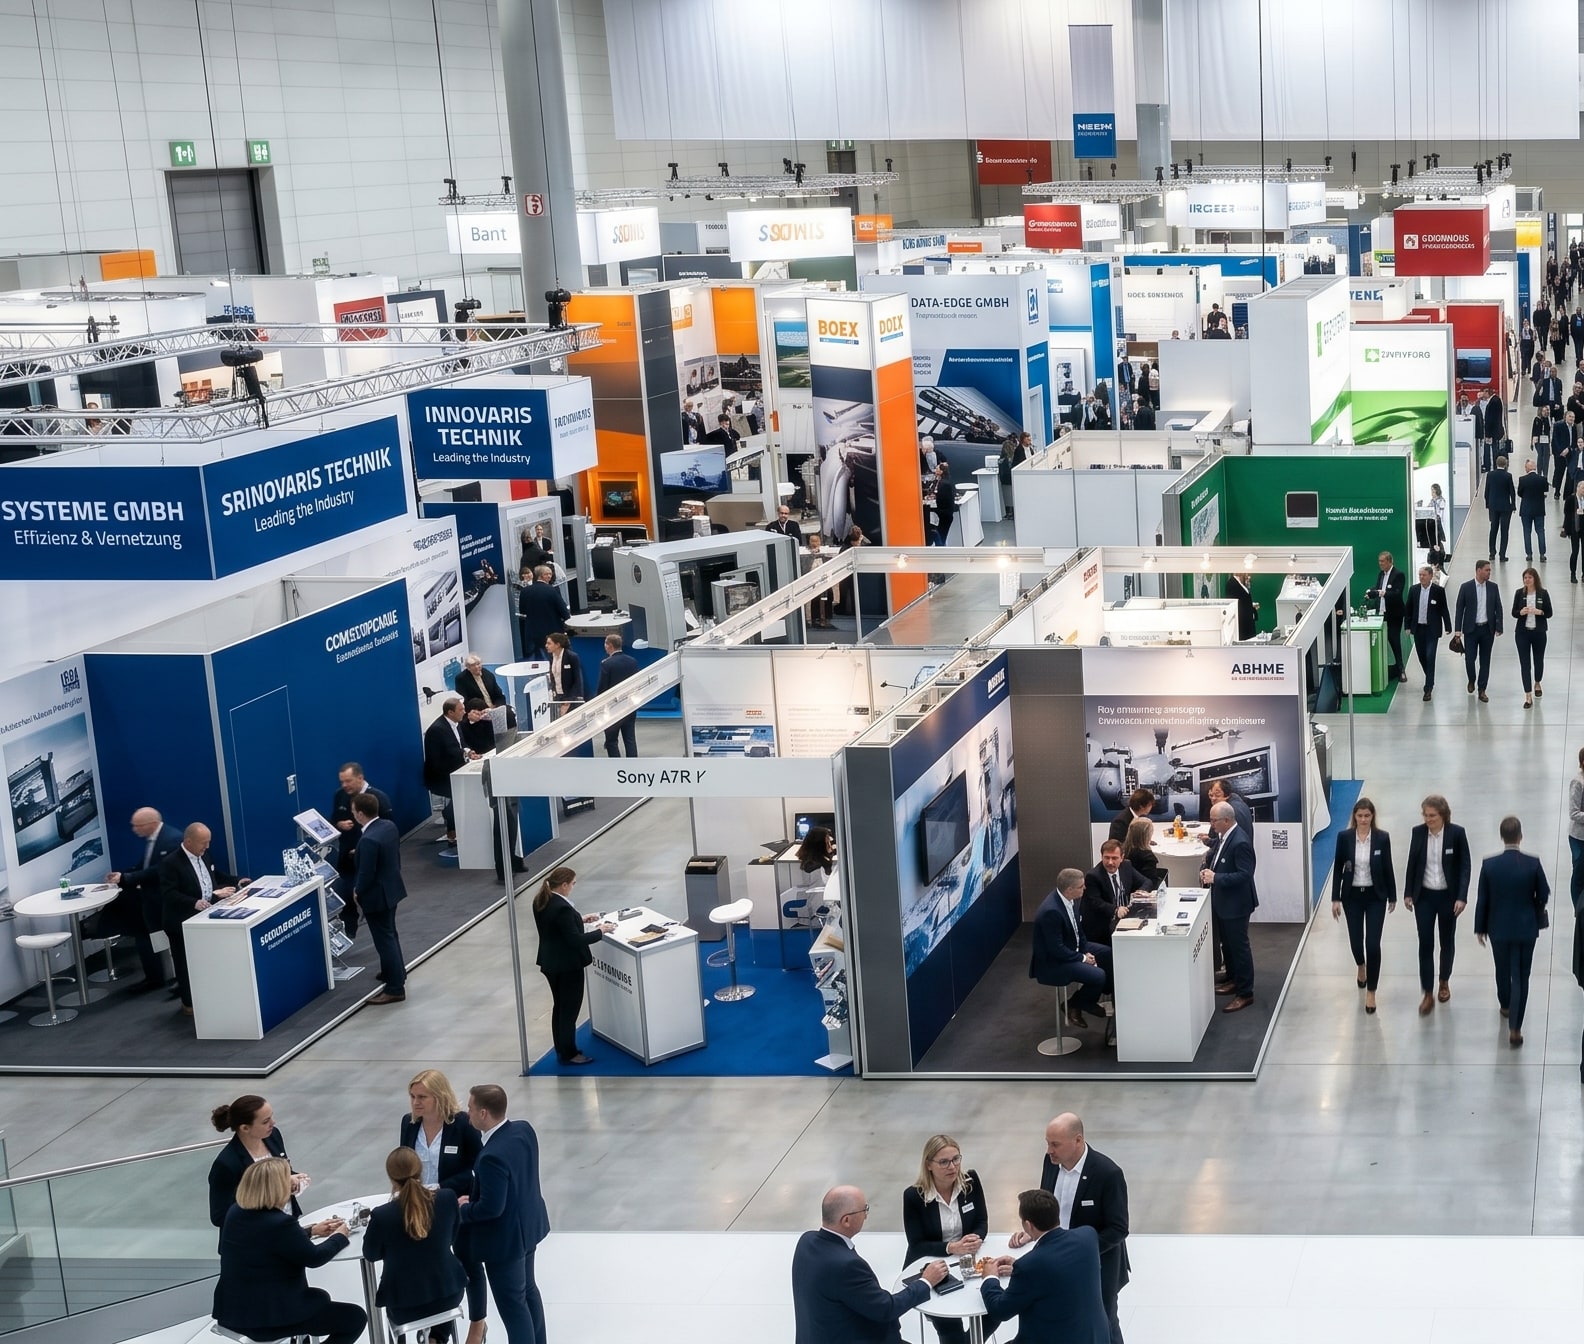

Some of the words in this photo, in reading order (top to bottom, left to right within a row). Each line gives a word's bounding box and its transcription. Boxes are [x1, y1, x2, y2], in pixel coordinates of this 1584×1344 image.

[471, 226, 508, 242] Bant
[911, 297, 972, 308] DATA-EDGE
[975, 297, 1009, 308] GMBH
[818, 319, 859, 338] BOEX
[425, 406, 532, 424] INNOVARIS
[437, 428, 523, 446] TECHNIK
[433, 452, 471, 465] Leading
[472, 453, 489, 463] the
[490, 453, 531, 466] Industry
[221, 466, 322, 517] SRINOVARIS
[323, 447, 393, 485] TECHNIK
[2, 500, 109, 522] SYSTEME
[113, 500, 185, 522] GMBH
[254, 508, 297, 533] Leading
[297, 502, 314, 520] the
[315, 487, 355, 514] Industry
[14, 529, 78, 546] Effizienz
[81, 531, 94, 546] &
[98, 531, 182, 550] Vernetzung
[1231, 663, 1285, 675] ABHME
[617, 770, 655, 787] Sony
[660, 770, 691, 783] A7R
